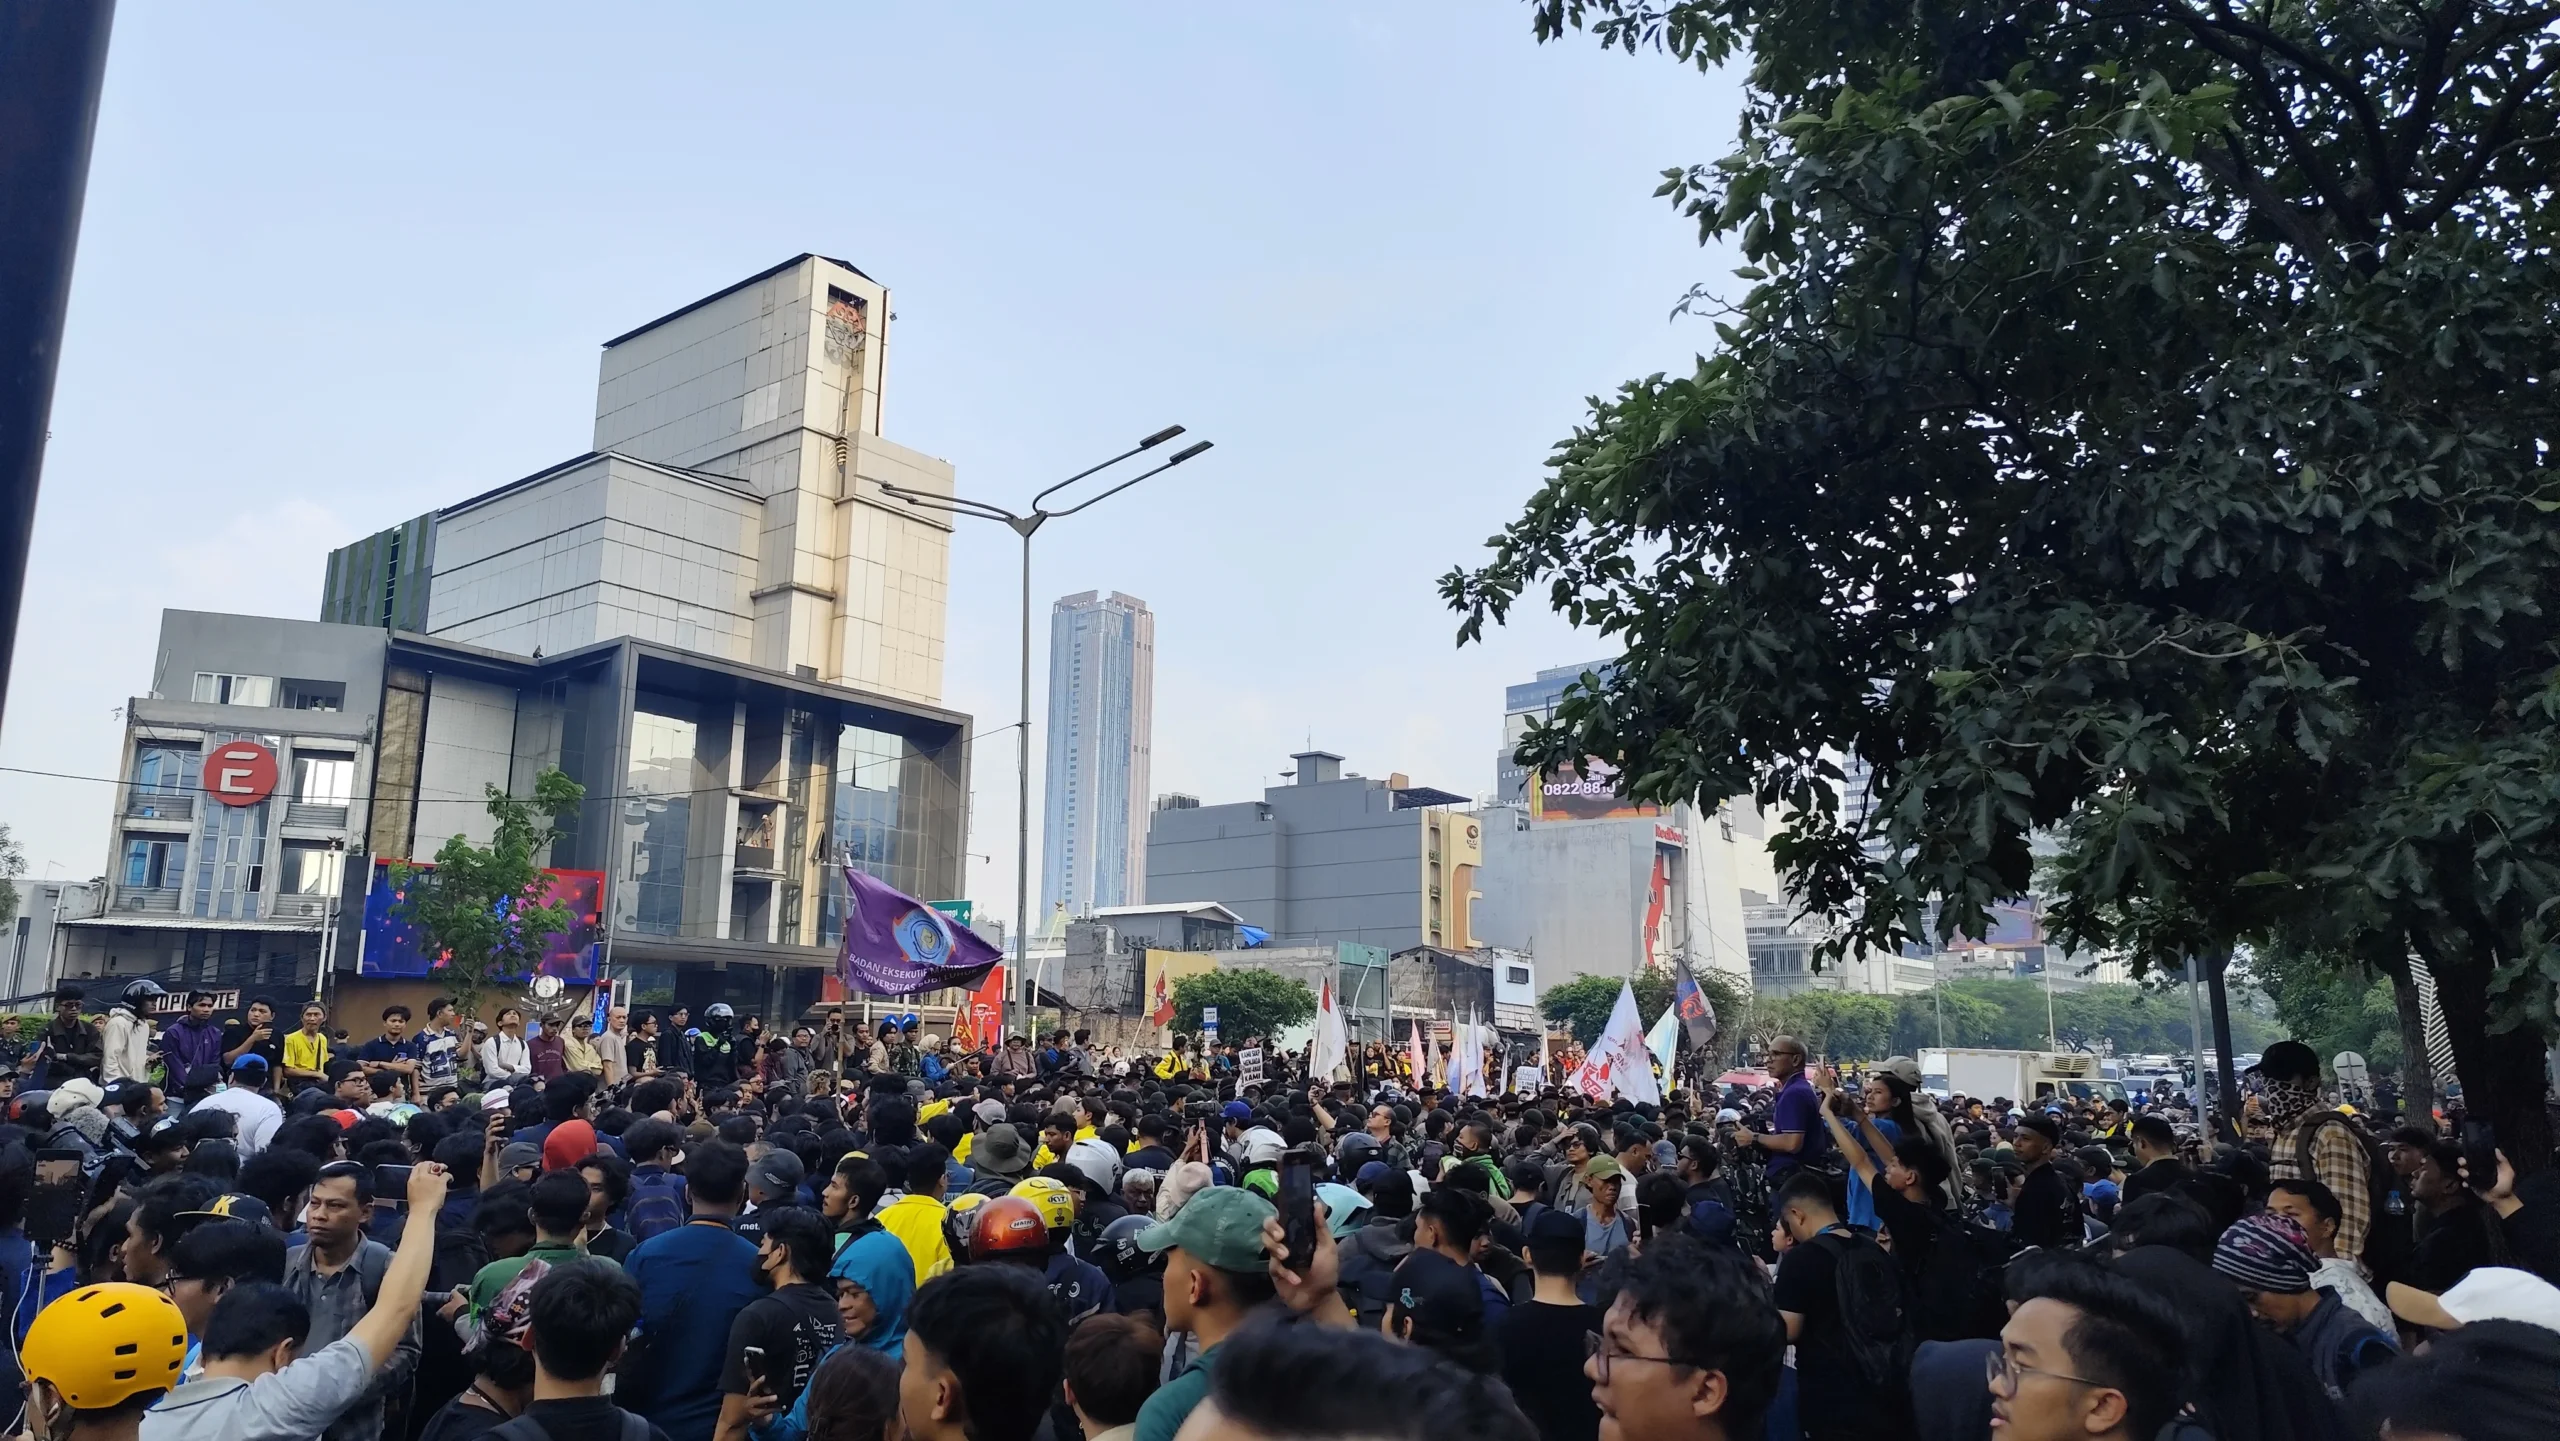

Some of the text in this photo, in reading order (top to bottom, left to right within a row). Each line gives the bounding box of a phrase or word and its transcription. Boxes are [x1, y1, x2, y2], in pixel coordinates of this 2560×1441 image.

[1543, 783, 1580, 796] 0822
[1655, 824, 1689, 845] RedDooz
[849, 953, 881, 973] BADAN
[882, 966, 928, 979] EKSEKUTIF
[856, 970, 916, 991] UNIVERSITAS
[1244, 1073, 1260, 1082] KAMI
